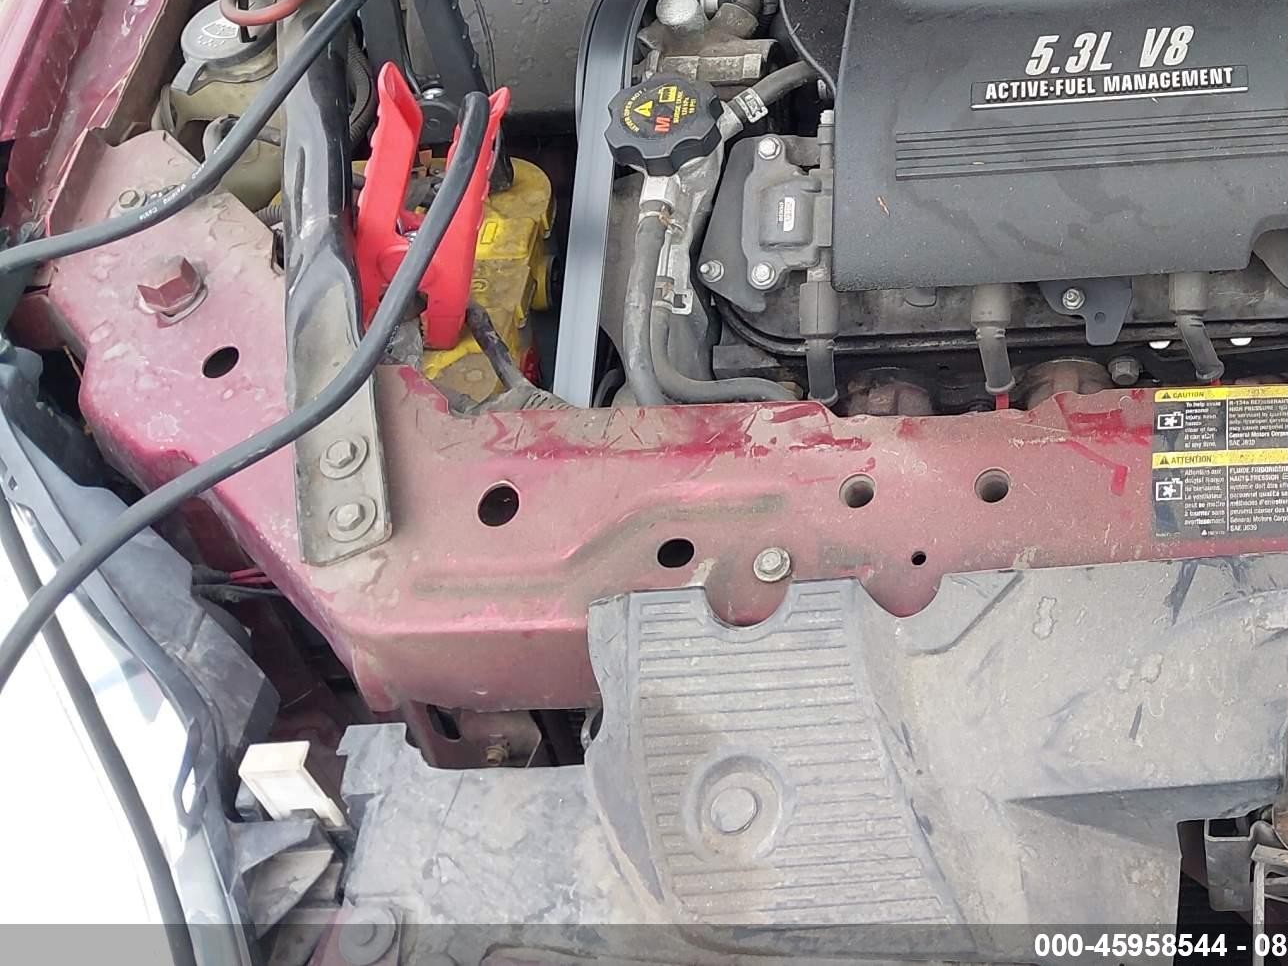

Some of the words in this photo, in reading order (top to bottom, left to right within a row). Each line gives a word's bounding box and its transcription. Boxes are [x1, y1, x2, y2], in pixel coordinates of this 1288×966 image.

[1025, 31, 1112, 75] 5.3L
[1140, 25, 1195, 68] V8
[1103, 67, 1233, 92] MANAGEMENT
[1171, 456, 1211, 464] ATTENTION
